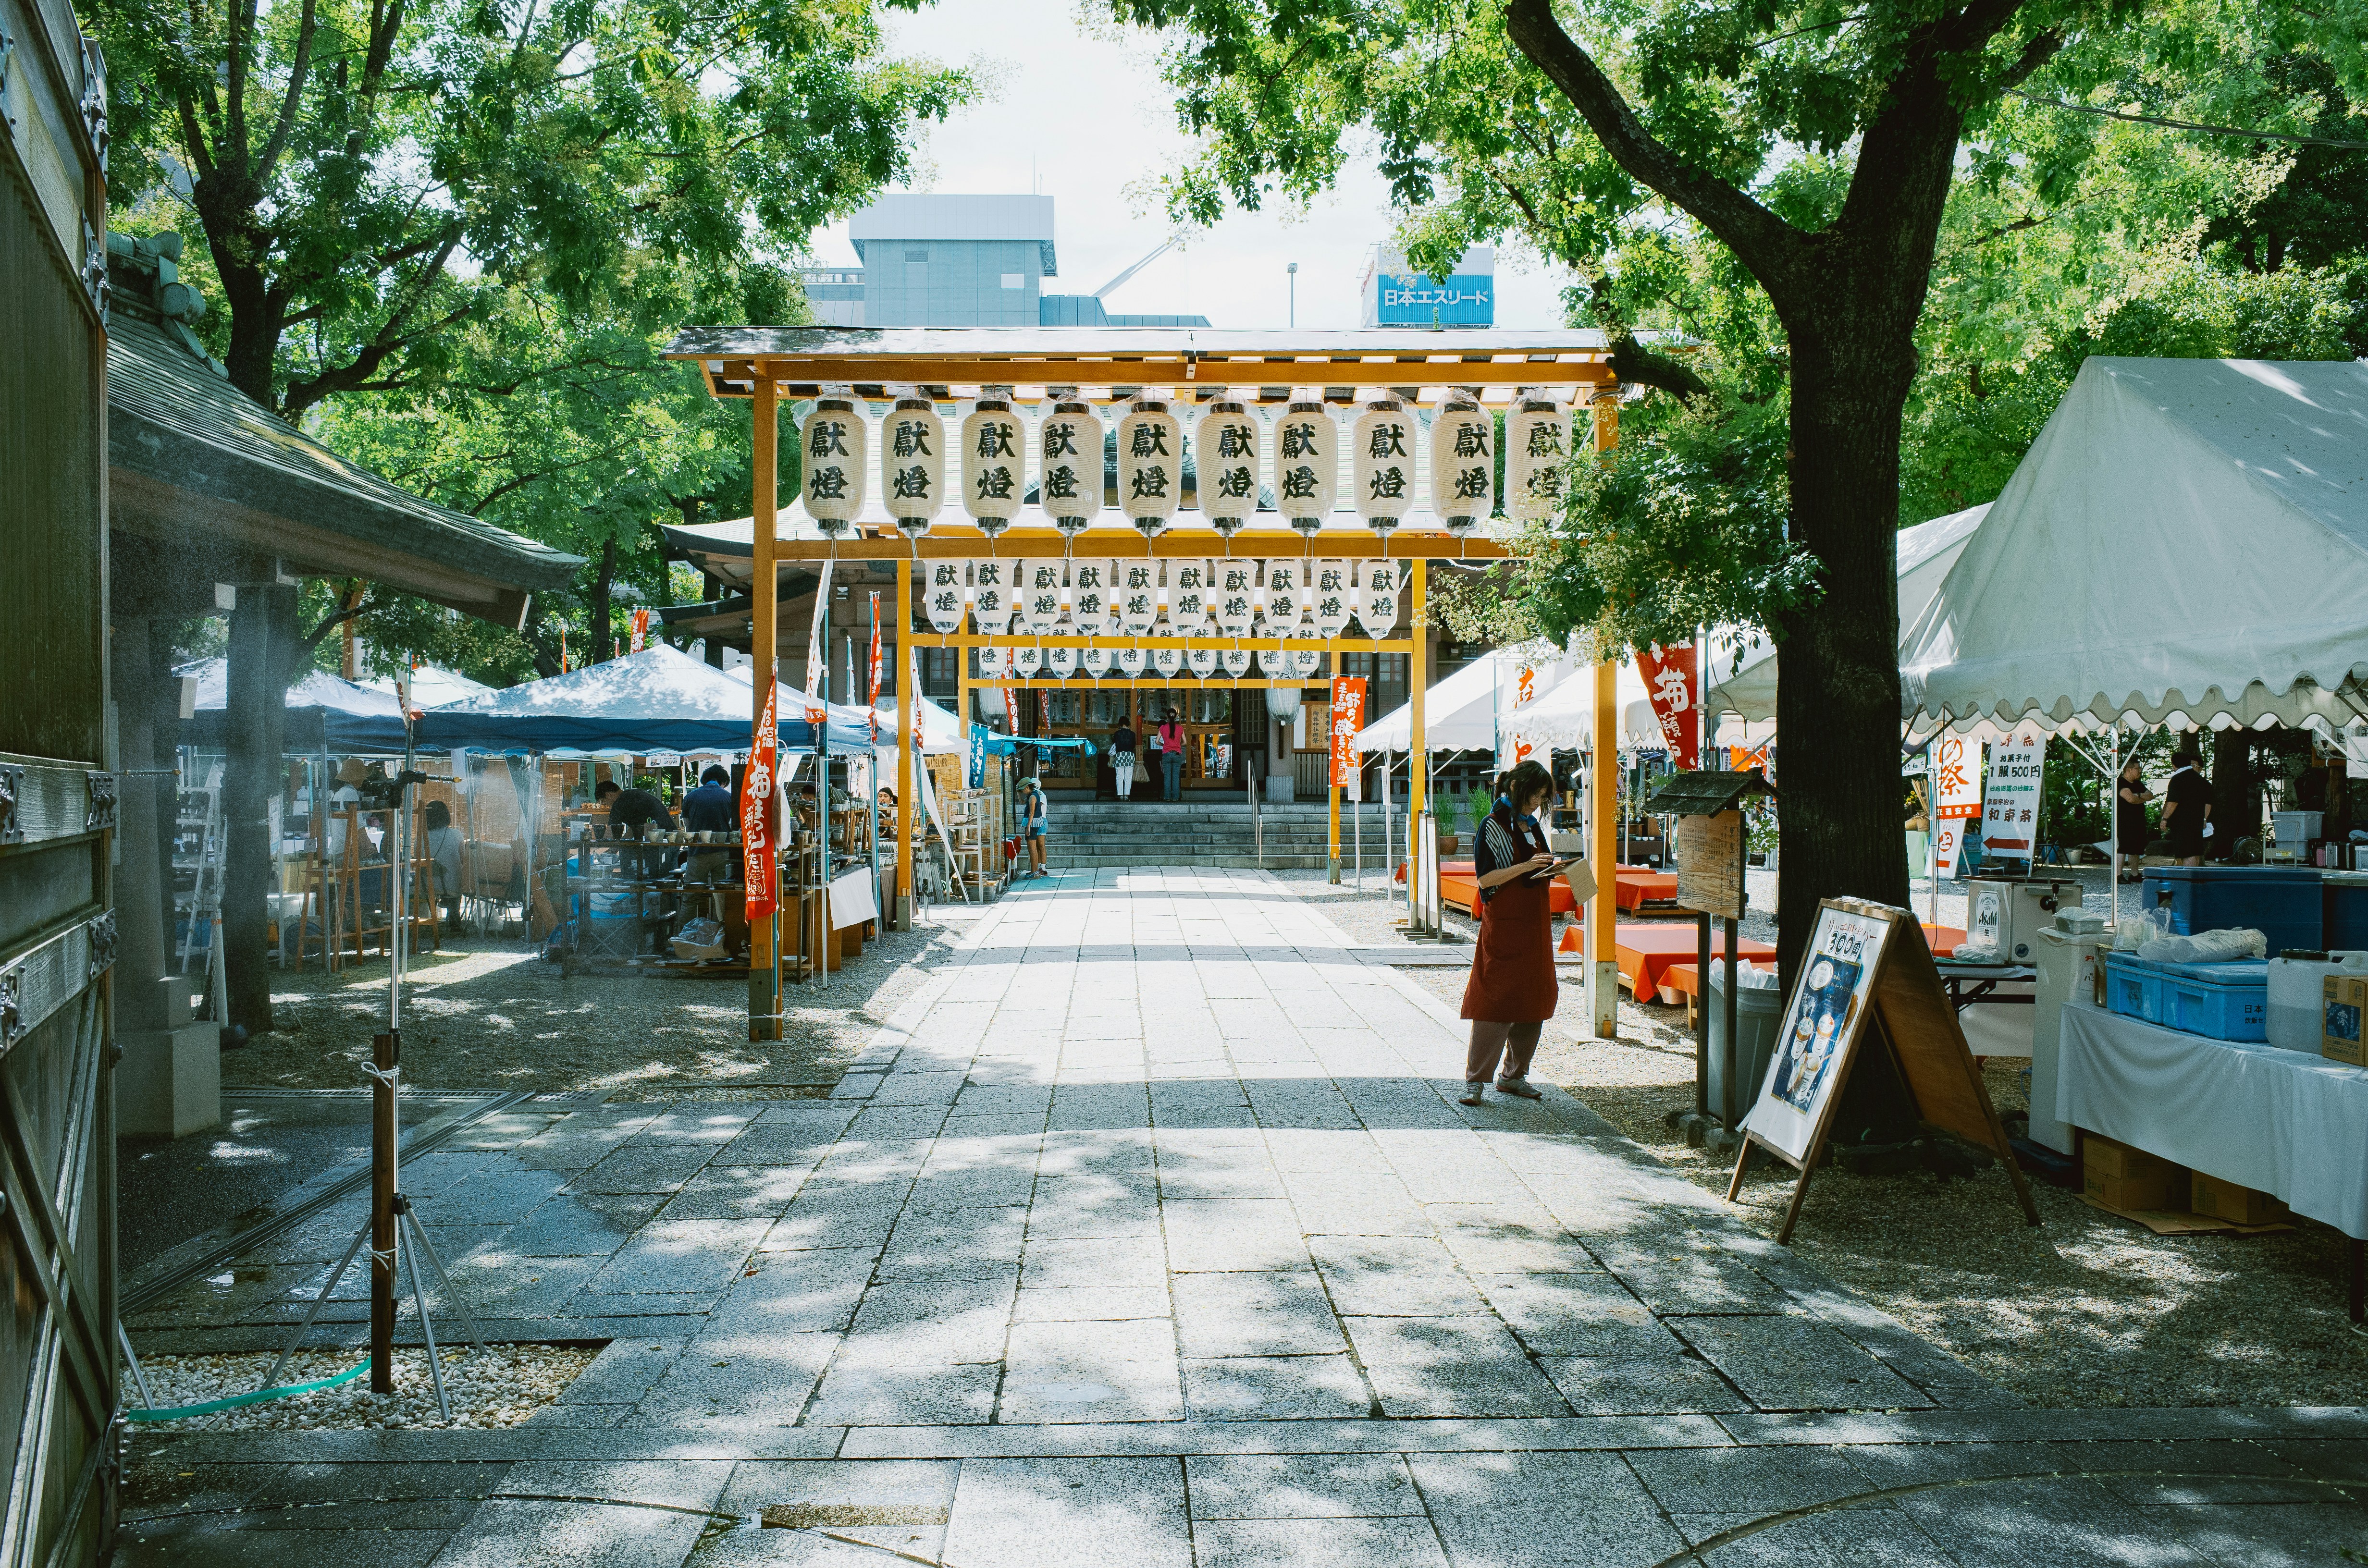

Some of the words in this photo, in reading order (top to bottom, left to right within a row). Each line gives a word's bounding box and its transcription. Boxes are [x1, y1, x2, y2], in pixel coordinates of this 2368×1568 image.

[1384, 288, 1489, 306] 日本エスリード
[1999, 753, 2031, 763] お菓子付
[1978, 910, 1997, 927] Asahi
